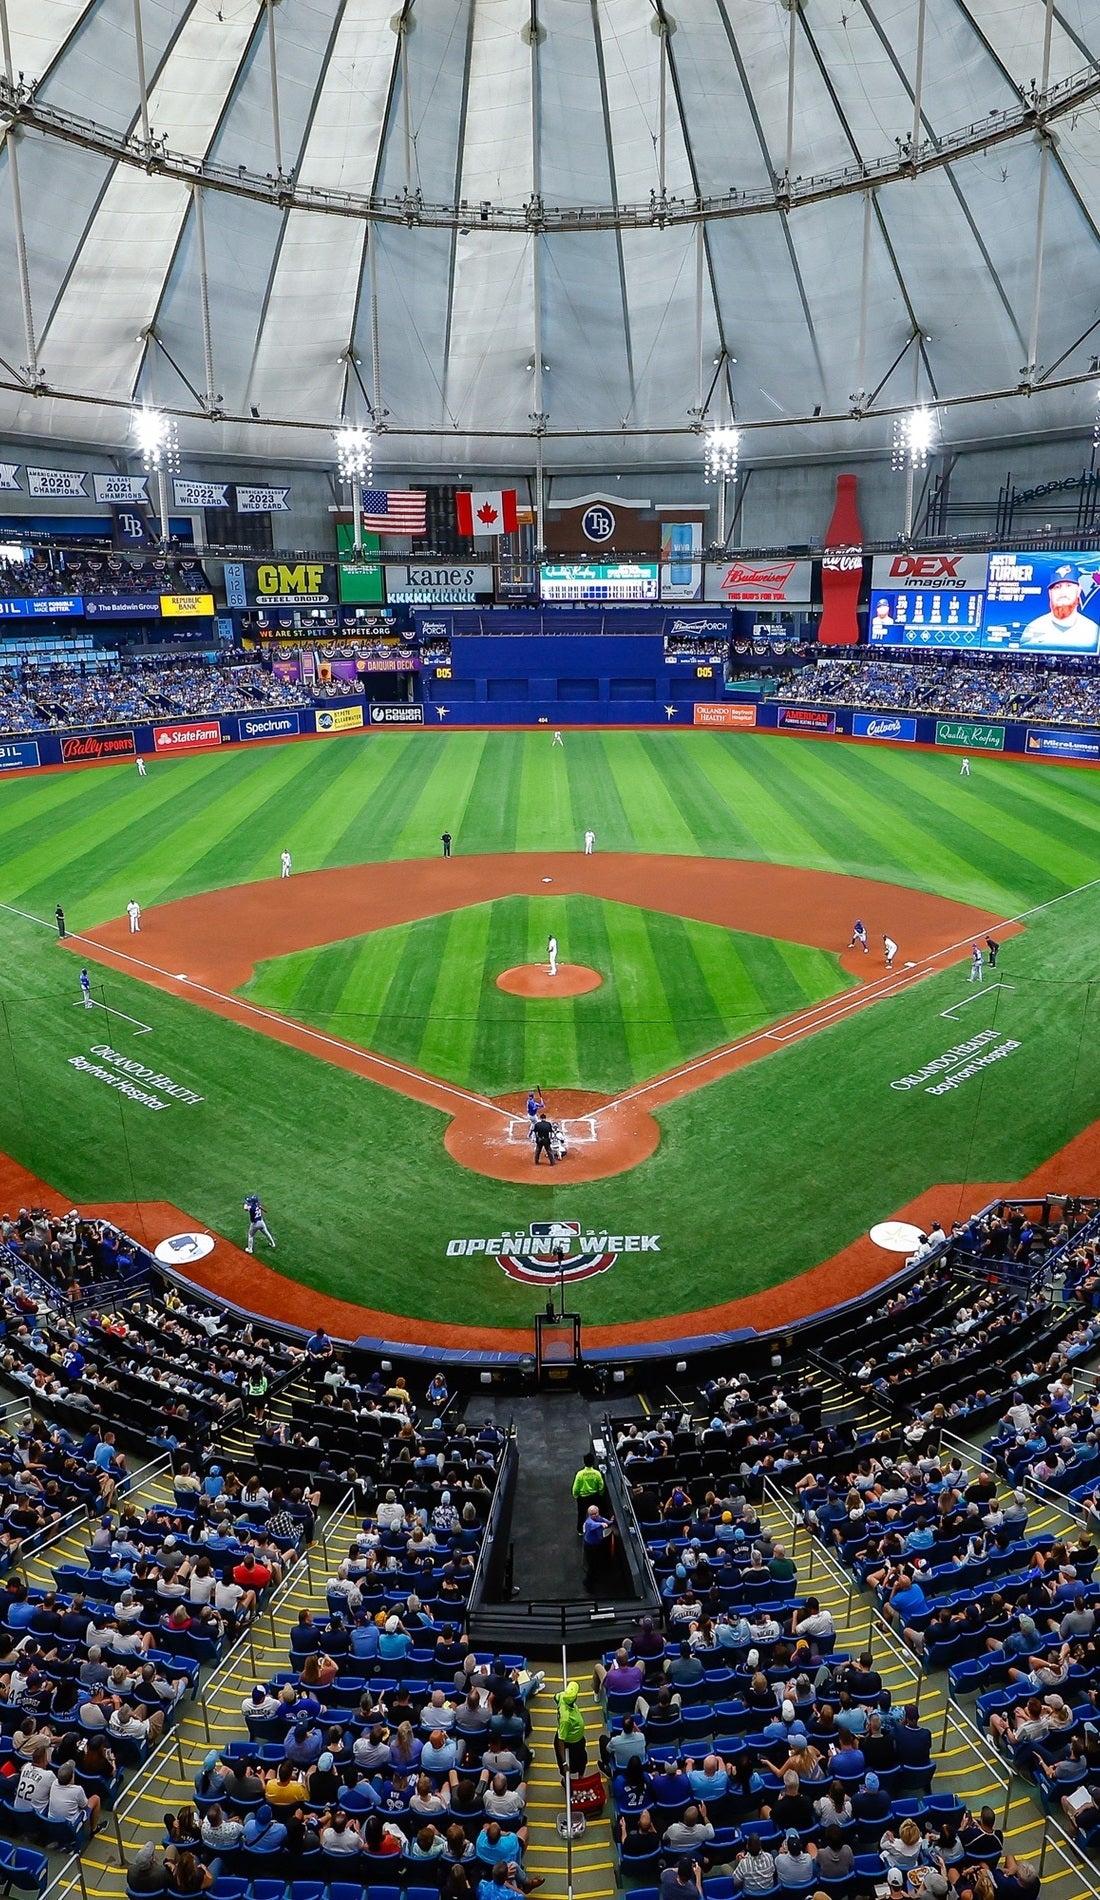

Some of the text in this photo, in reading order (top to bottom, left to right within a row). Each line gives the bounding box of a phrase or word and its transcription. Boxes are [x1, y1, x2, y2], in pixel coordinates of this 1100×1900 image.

[41, 478, 71, 488] 2020
[106, 483, 131, 492] 2021
[33, 487, 80, 495] CHAMPIONS
[187, 489, 214, 499] 2022
[249, 495, 274, 503] 2023
[119, 514, 143, 538] TB
[589, 512, 609, 534] TB
[228, 566, 241, 576] 42
[889, 557, 963, 577] DEX
[258, 565, 324, 594] GMF
[405, 565, 474, 585] kane's
[728, 570, 788, 583] Budweiser
[990, 566, 1033, 581] TURNER
[230, 581, 240, 590] 12
[905, 577, 966, 588] imaging
[231, 595, 242, 604] 66
[703, 622, 728, 630] PORCH
[260, 630, 273, 638] WE
[367, 660, 415, 670] DAIQUIRI DECK
[697, 667, 712, 678] 0:05
[697, 706, 729, 714] ORLANDO
[700, 713, 726, 721] HEALTH
[786, 711, 828, 722] AMERICAN
[245, 720, 290, 735] Spectrum
[867, 720, 900, 736] Culver's
[940, 725, 1000, 746] Quality Roofing
[64, 738, 133, 757] Bally SPORTS
[1043, 739, 1099, 750] MicroLumen
[890, 1030, 1001, 1090] ORLANDO HEALTH
[924, 1039, 1022, 1095] Bayfront Hospital
[90, 1045, 204, 1105] ORLANDO HEALTH
[68, 1056, 171, 1110] Bayfront Hospital
[446, 1235, 660, 1256] OPENING WEEK
[17, 1781, 35, 1800] 22
